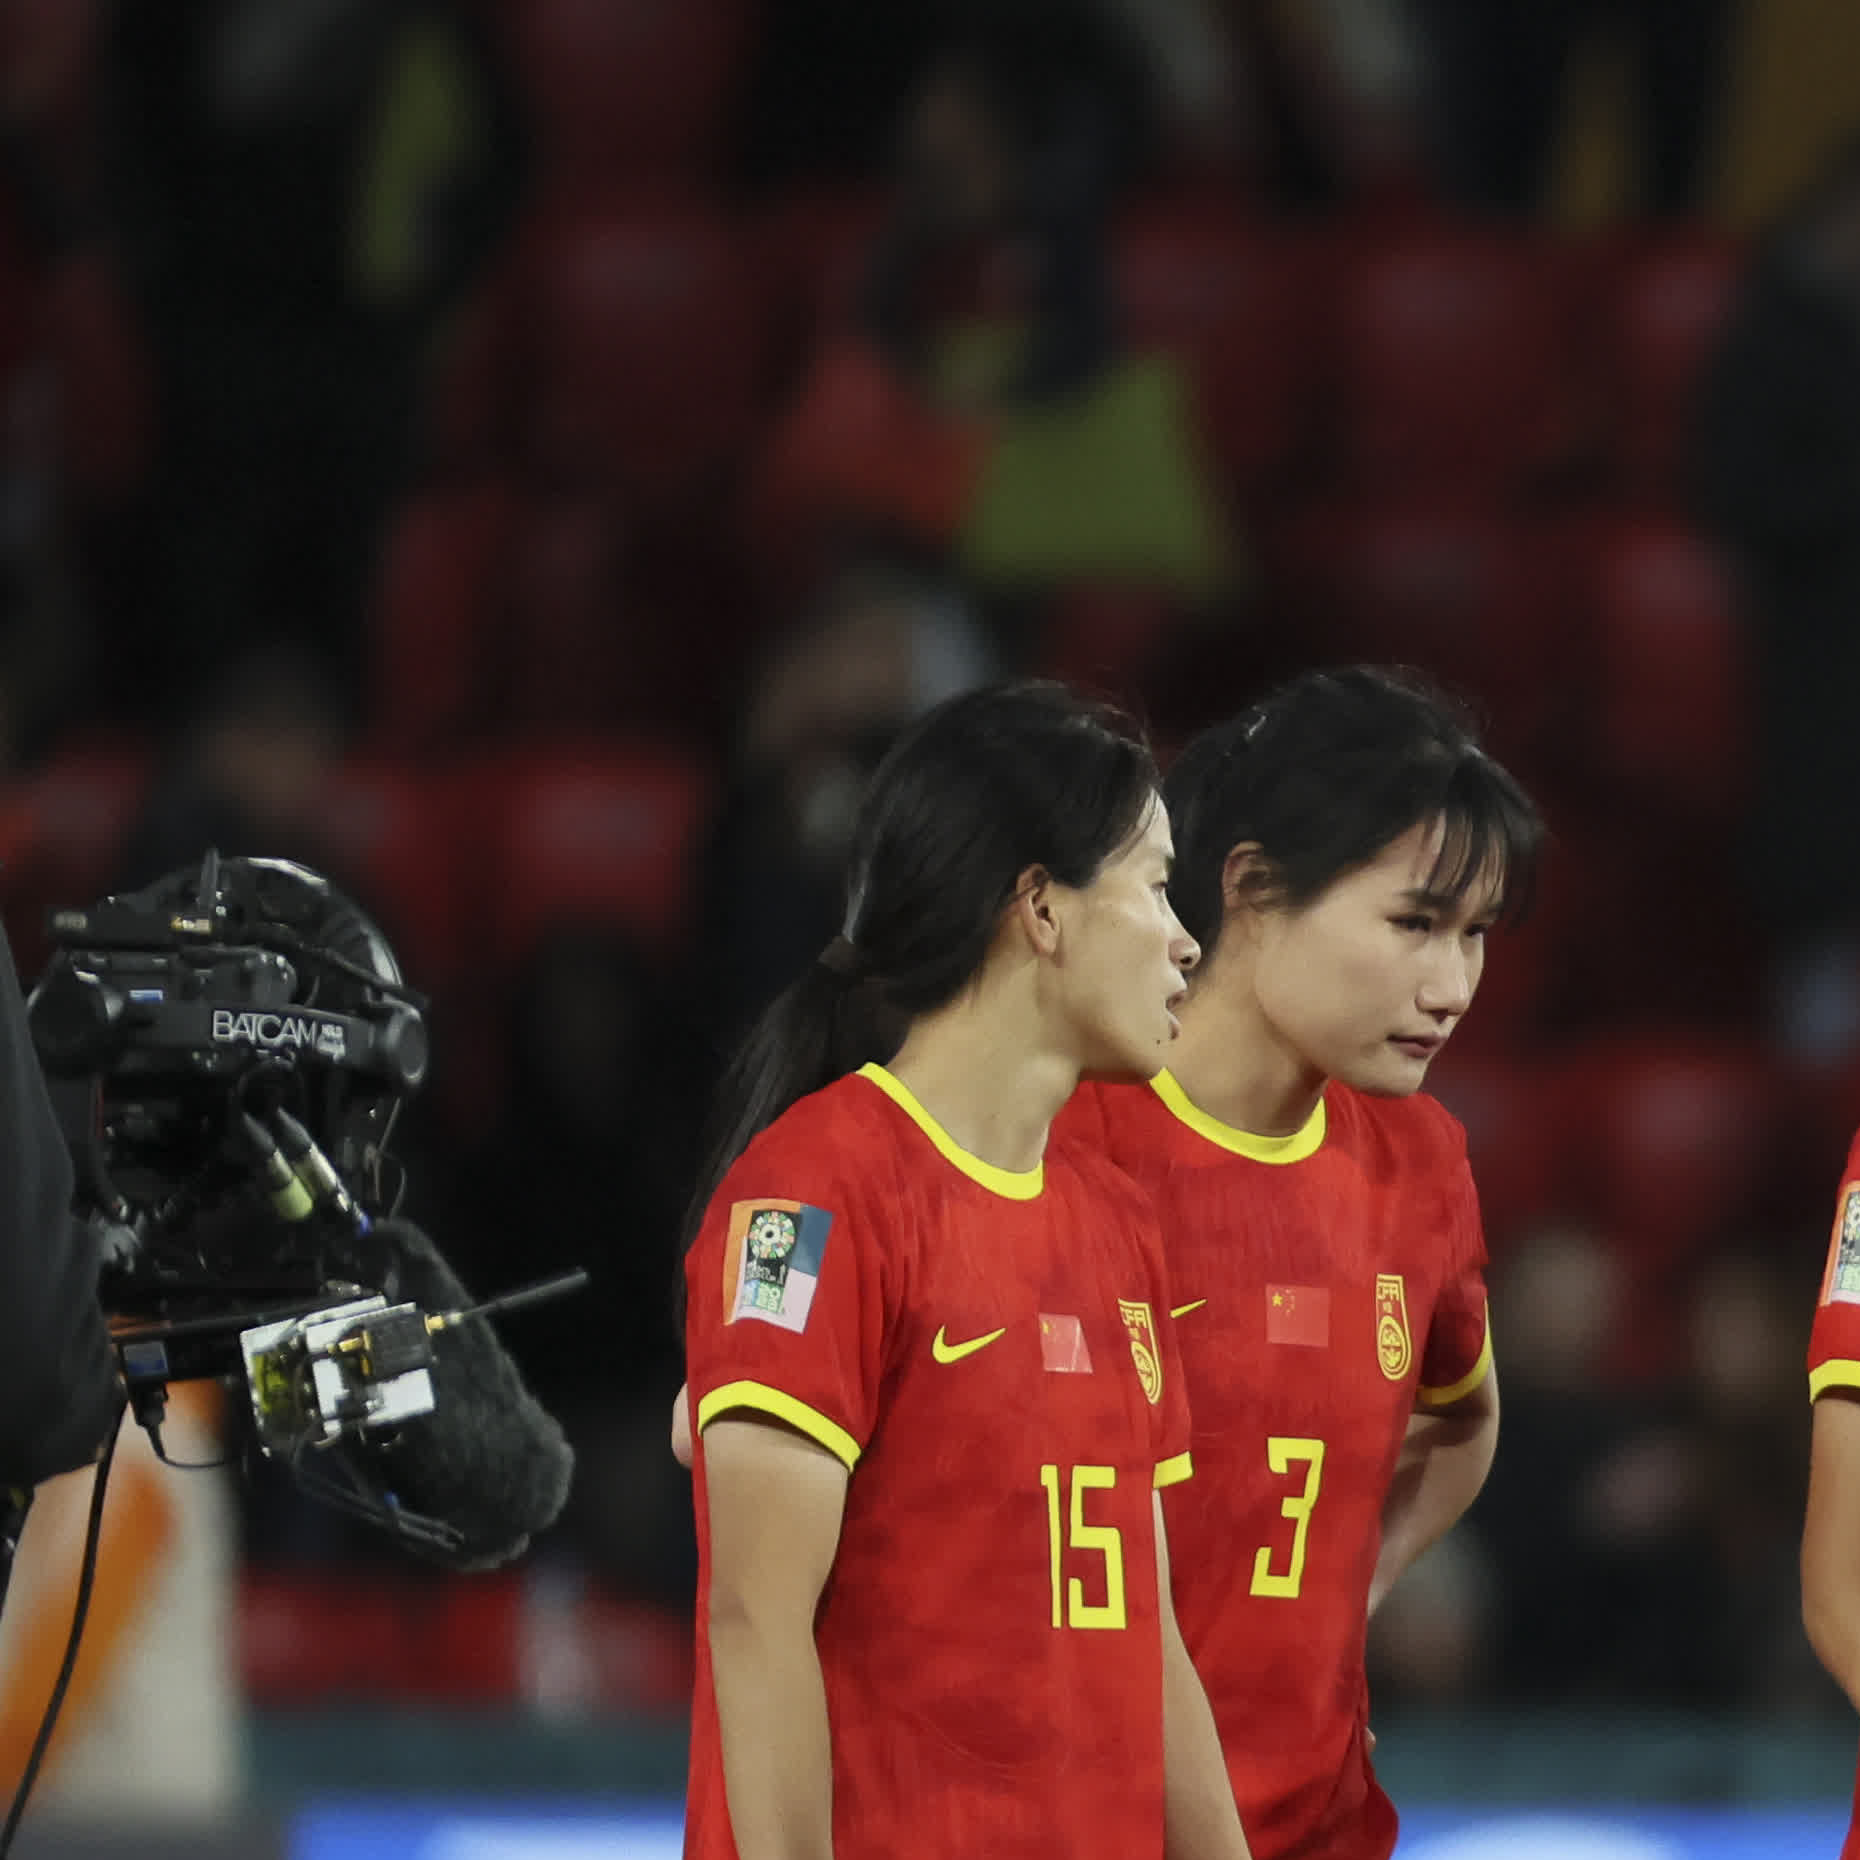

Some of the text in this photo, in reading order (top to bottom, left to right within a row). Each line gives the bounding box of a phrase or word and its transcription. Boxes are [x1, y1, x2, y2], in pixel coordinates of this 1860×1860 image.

[213, 1010, 317, 1049] BATCAM
[1041, 1464, 1127, 1629] 15
[1250, 1436, 1326, 1598] 3
